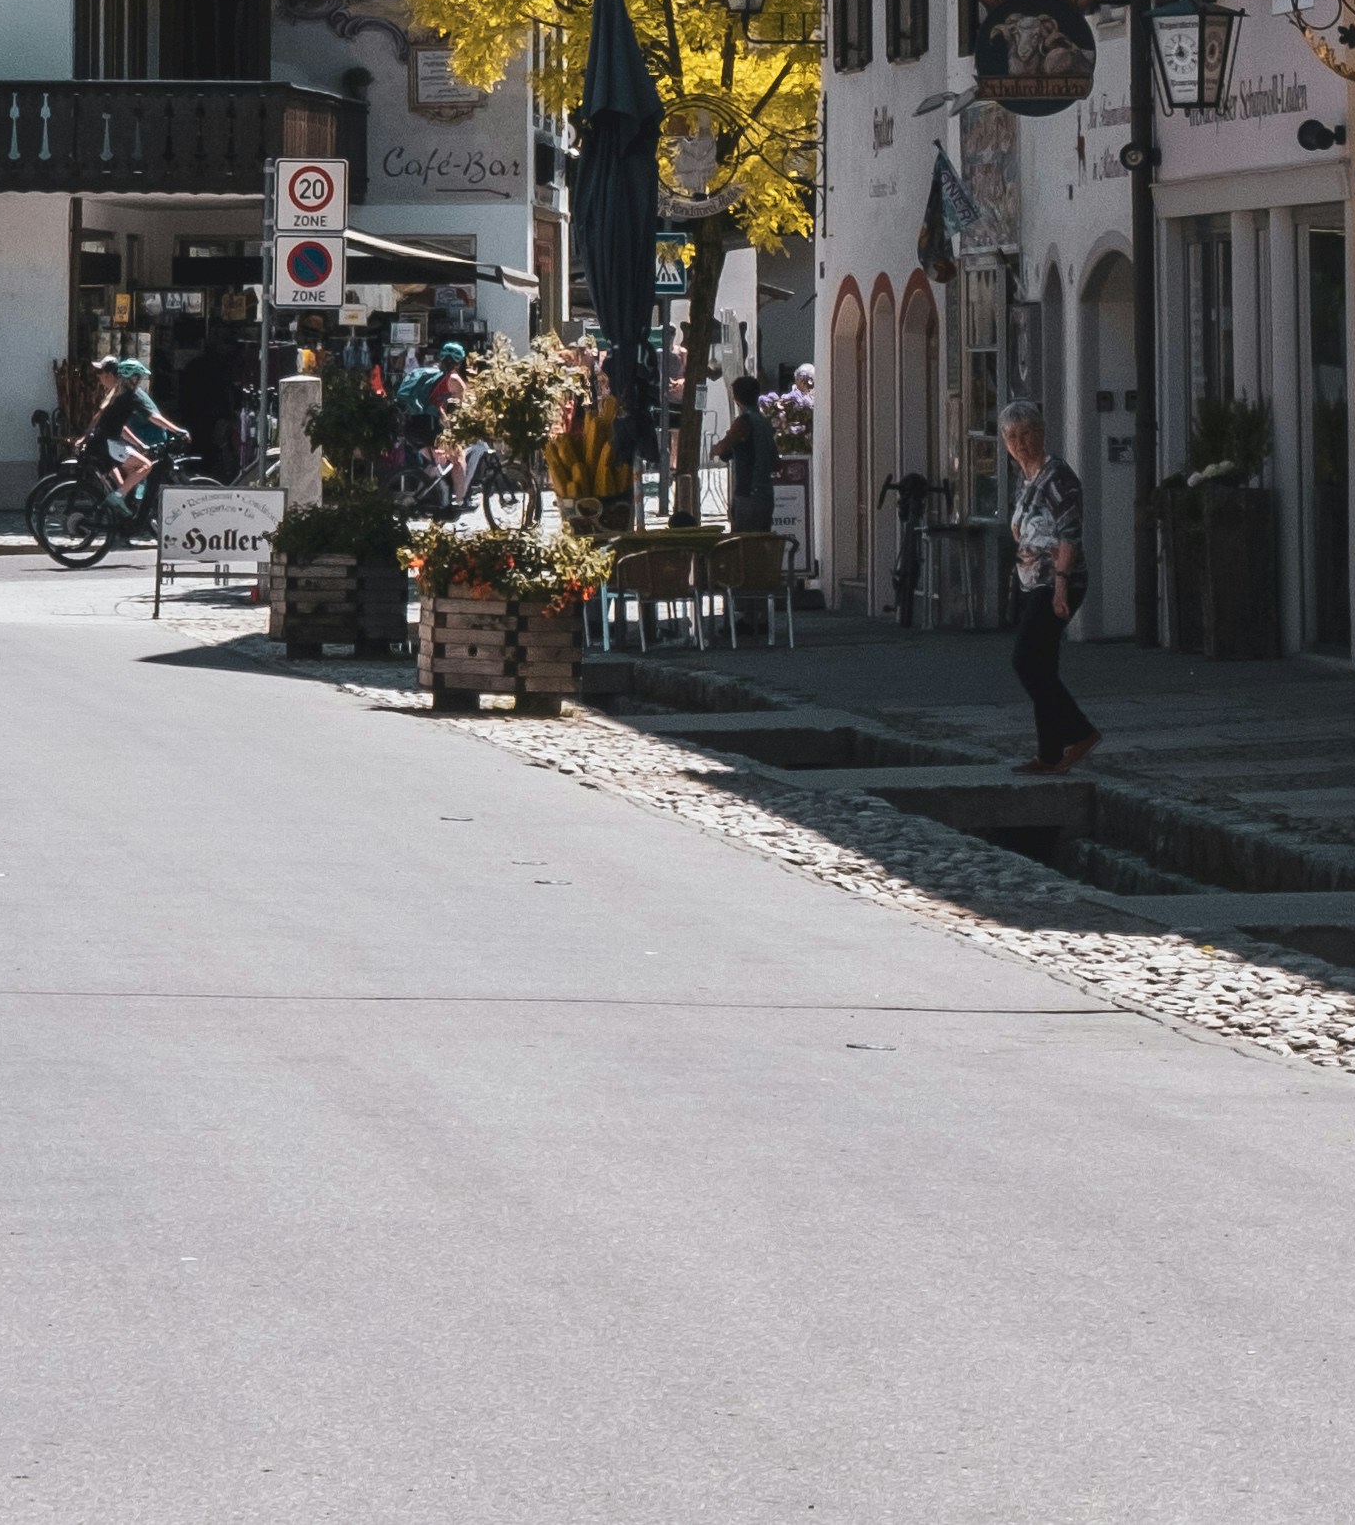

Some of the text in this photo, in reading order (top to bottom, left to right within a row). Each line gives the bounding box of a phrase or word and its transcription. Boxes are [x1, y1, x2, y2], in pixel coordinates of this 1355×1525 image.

[383, 145, 521, 186] Café-Bar
[299, 178, 325, 200] 20
[293, 215, 328, 227] ZONE
[291, 290, 326, 302] ZONE
[181, 527, 262, 555] Haller
